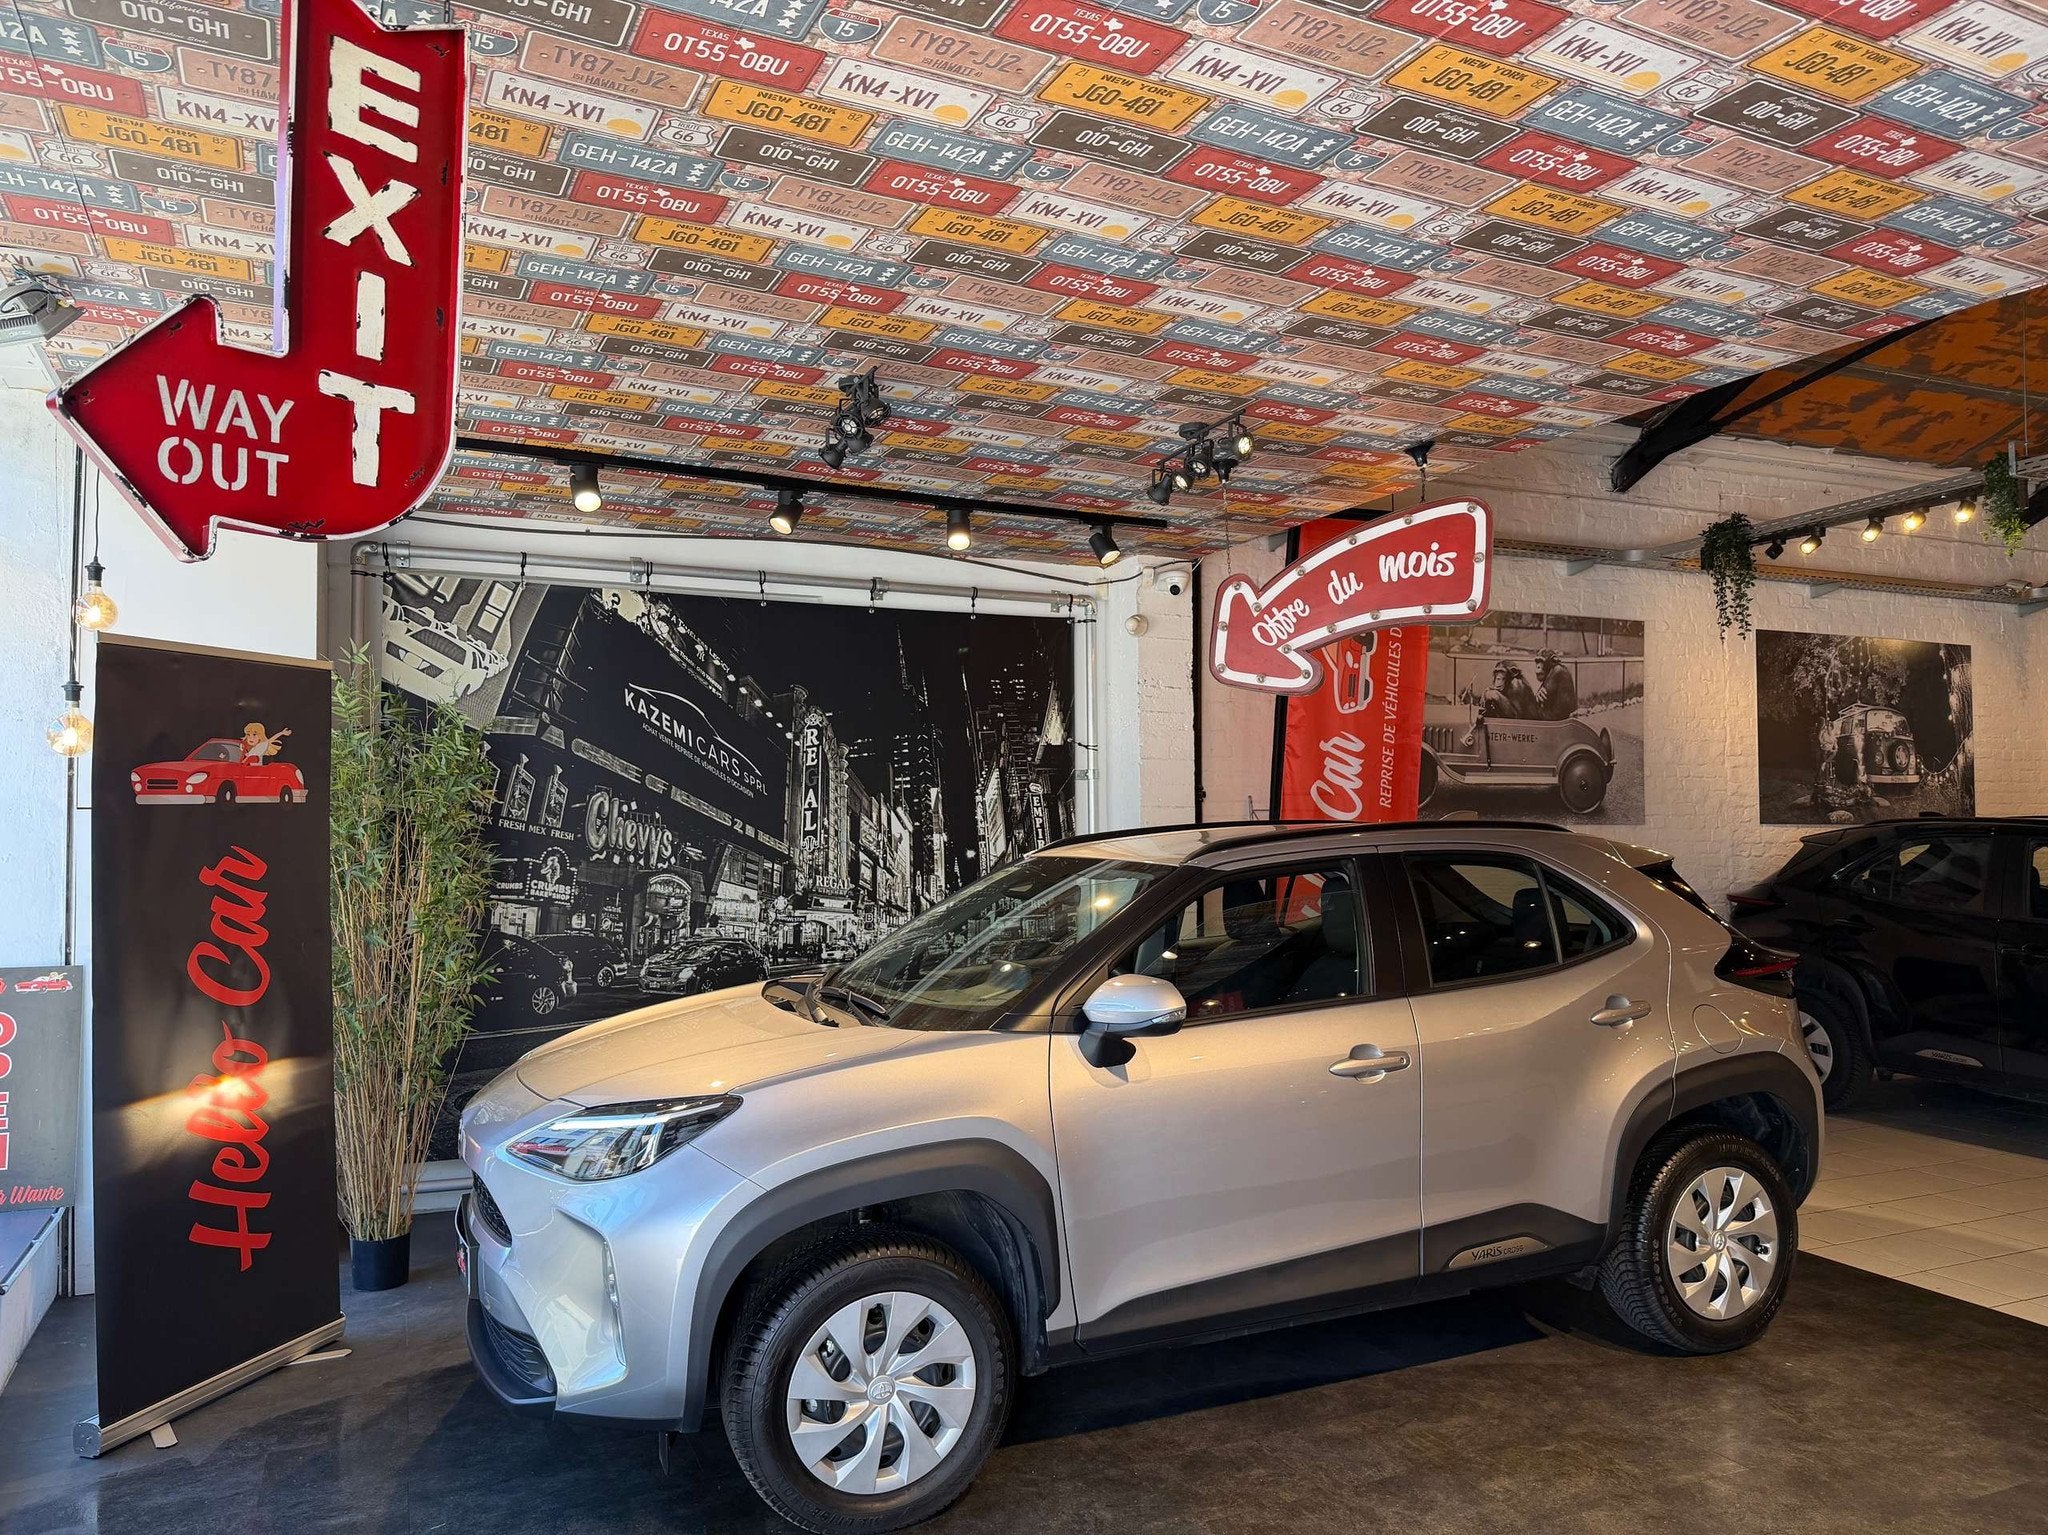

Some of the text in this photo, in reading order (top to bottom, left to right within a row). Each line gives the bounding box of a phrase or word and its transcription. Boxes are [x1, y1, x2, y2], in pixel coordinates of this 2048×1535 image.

[1073, 9, 1102, 22] TEXAS
[1209, 1, 1238, 19] 15
[701, 28, 730, 41] TEXAS
[834, 20, 858, 37] 15
[1280, 9, 1388, 58] TY87-JJ2
[126, 50, 149, 66] 15
[910, 27, 1023, 74] TY87-JJ2
[1433, 50, 1452, 60] 21
[1828, 40, 1902, 66] NEW YORK
[553, 46, 671, 90] TY87-JJ2
[1074, 68, 1090, 77] 21
[1458, 57, 1536, 82] NEW YORK
[1100, 74, 1182, 98] NEW YORK
[1676, 84, 1707, 98] 66
[757, 91, 843, 114] NEW YORK
[1329, 101, 1356, 114] 66
[1892, 84, 1987, 121] GEH-142A
[994, 116, 1018, 129] 66
[1434, 112, 1487, 127] California
[1544, 101, 1642, 136] GEH-142A
[1996, 122, 2030, 136] 15
[672, 130, 694, 142] 66
[1100, 126, 1155, 140] California
[1208, 116, 1308, 151] GEH-142A
[884, 131, 987, 164] GEH-142A
[1665, 139, 1694, 152] 15
[59, 152, 83, 164] 66
[571, 143, 677, 175] GEH-142A
[1343, 154, 1368, 166] 15
[733, 176, 752, 188] 15
[924, 172, 947, 181] TEXAS
[1033, 165, 1055, 177] 15
[1400, 159, 1488, 192] TY87-JJ2
[796, 184, 889, 215] TY87-JJ2
[1093, 172, 1183, 204] TY87-JJ2
[159, 200, 177, 211] 15
[507, 194, 605, 224] TY87-JJ2
[317, 34, 421, 488] EXIT
[157, 373, 295, 444] WAY
[157, 436, 290, 497] OUT
[1252, 542, 1457, 646] Offre du mois
[1382, 641, 1401, 720] VÉHICULES
[624, 688, 768, 795] KAZEMI CARS SPRL
[660, 733, 675, 748] VENTE
[1383, 722, 1396, 744] DE
[803, 727, 820, 831] REGAL
[1311, 731, 1366, 820] Car
[1379, 746, 1395, 808] REPRISE
[498, 819, 525, 832] FRESH
[529, 824, 546, 835] MEX
[551, 829, 574, 841] FRESH
[586, 791, 673, 869] Chevys
[531, 880, 571, 895] CRUMBS
[187, 845, 270, 1007] Car
